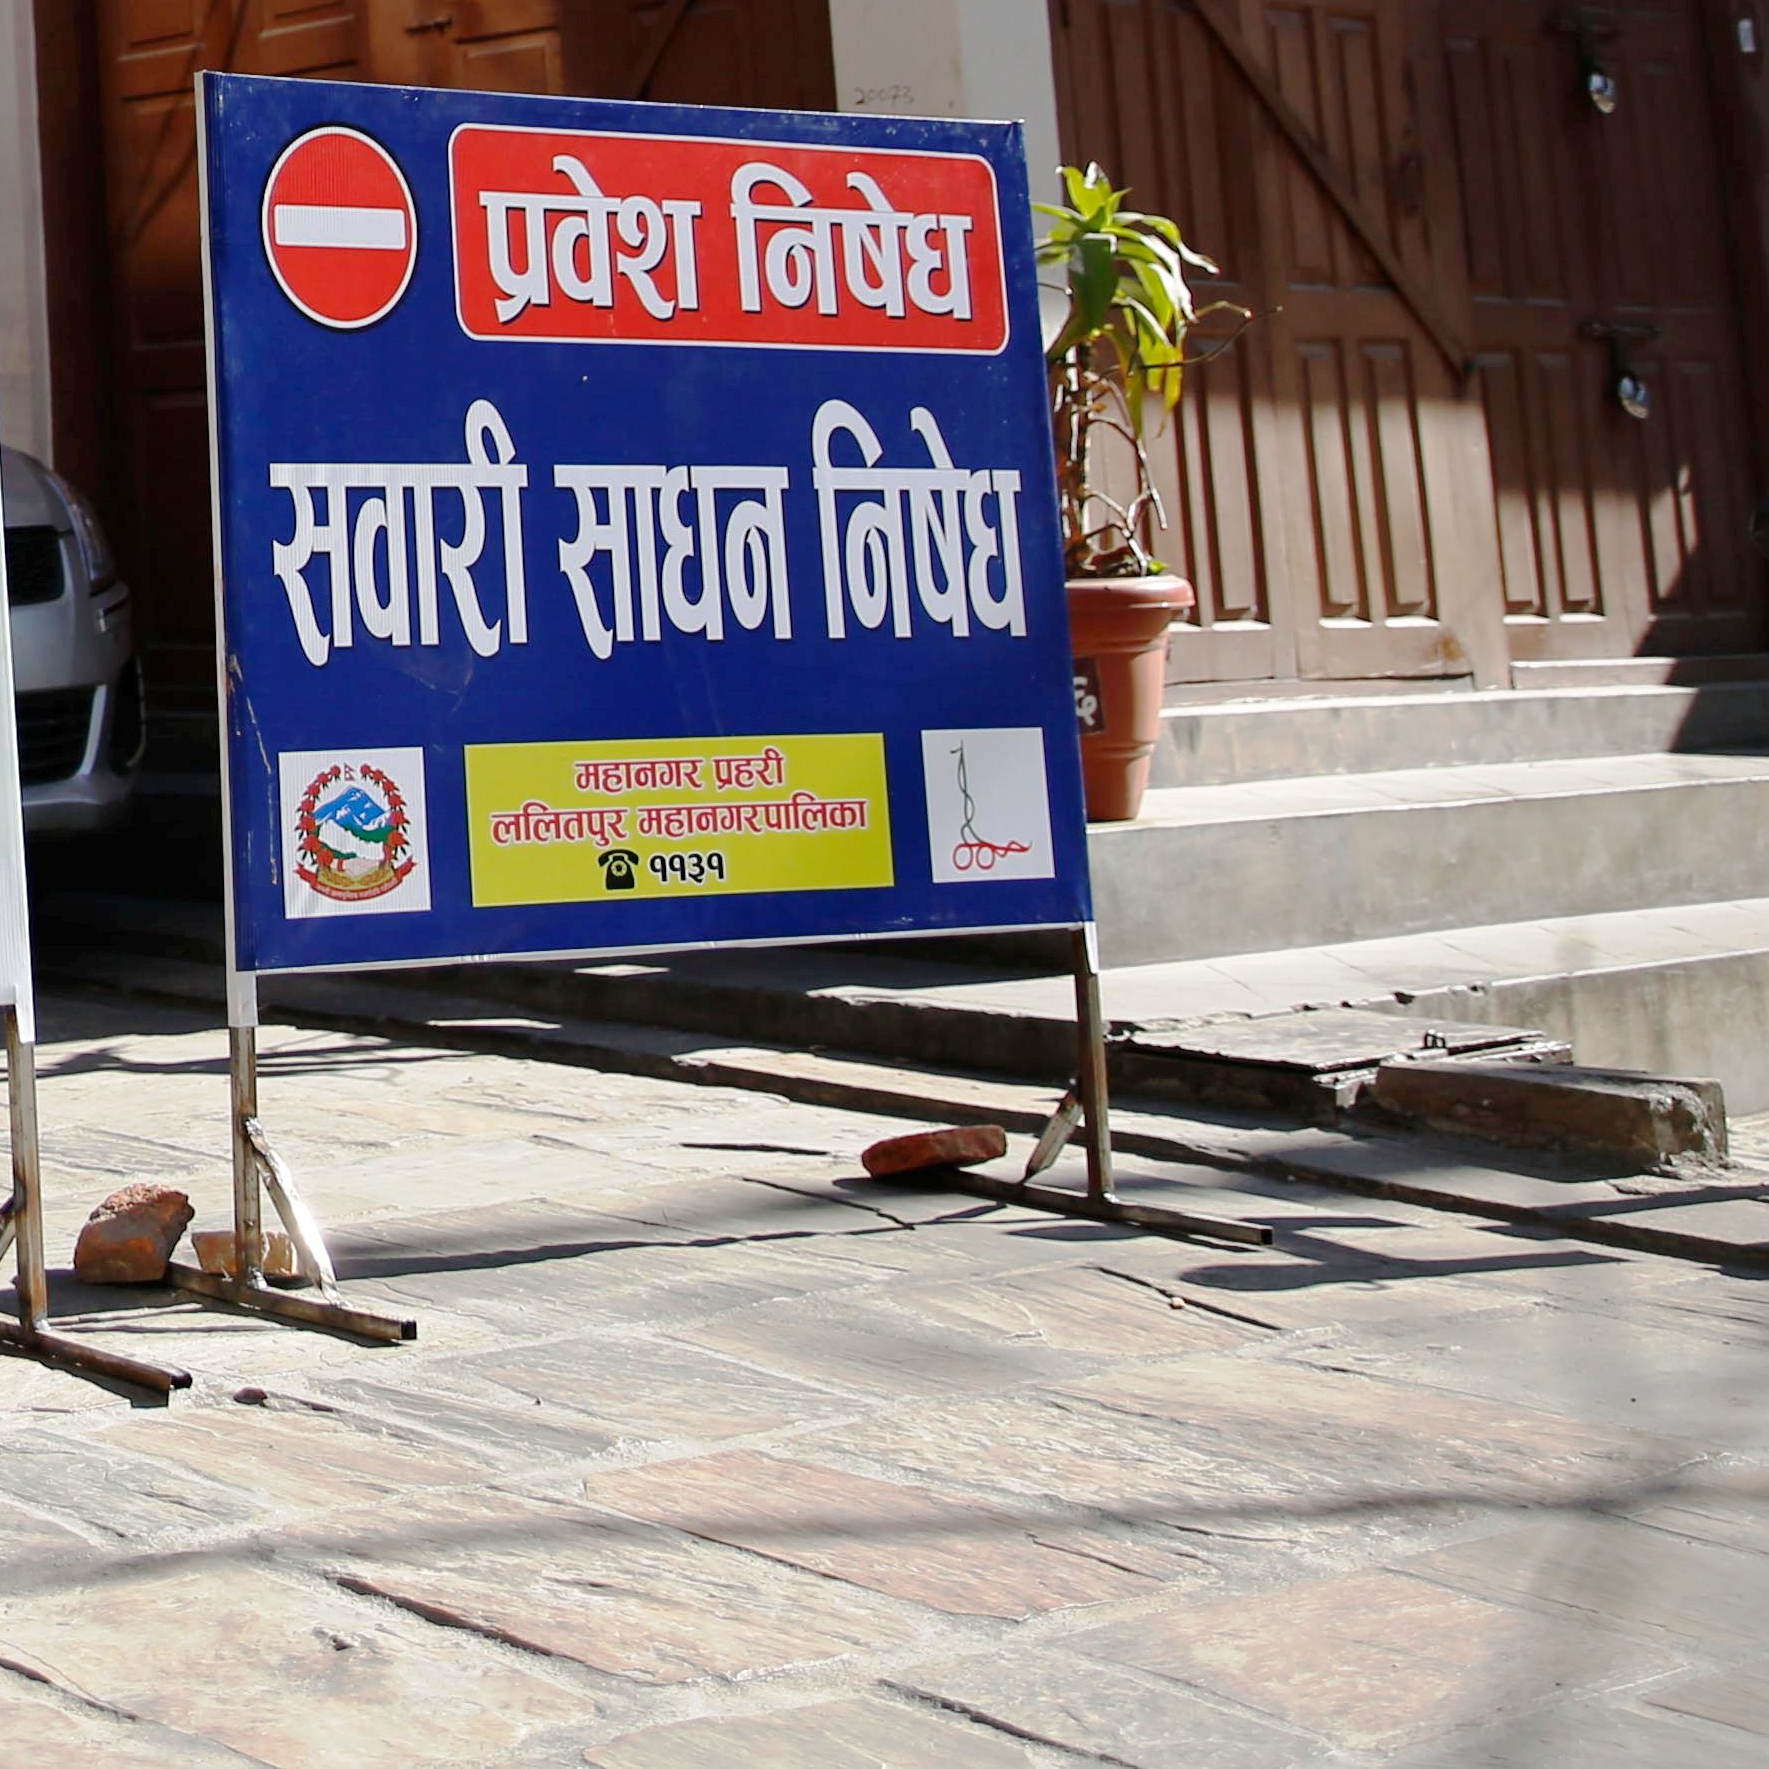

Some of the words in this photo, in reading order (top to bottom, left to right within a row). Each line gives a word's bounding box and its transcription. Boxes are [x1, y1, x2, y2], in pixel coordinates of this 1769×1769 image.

[478, 153, 703, 324] प्रवेश
[730, 160, 973, 321] निषेध
[269, 398, 529, 667] सवारी
[554, 464, 792, 660] साधन
[812, 398, 1026, 639] निषेध
[576, 754, 705, 796] महानगर
[714, 747, 786, 791] प्रहरी
[490, 807, 629, 847] ललितपुर
[638, 792, 868, 838] महानगरपालिका
[648, 852, 726, 885] ११३१
